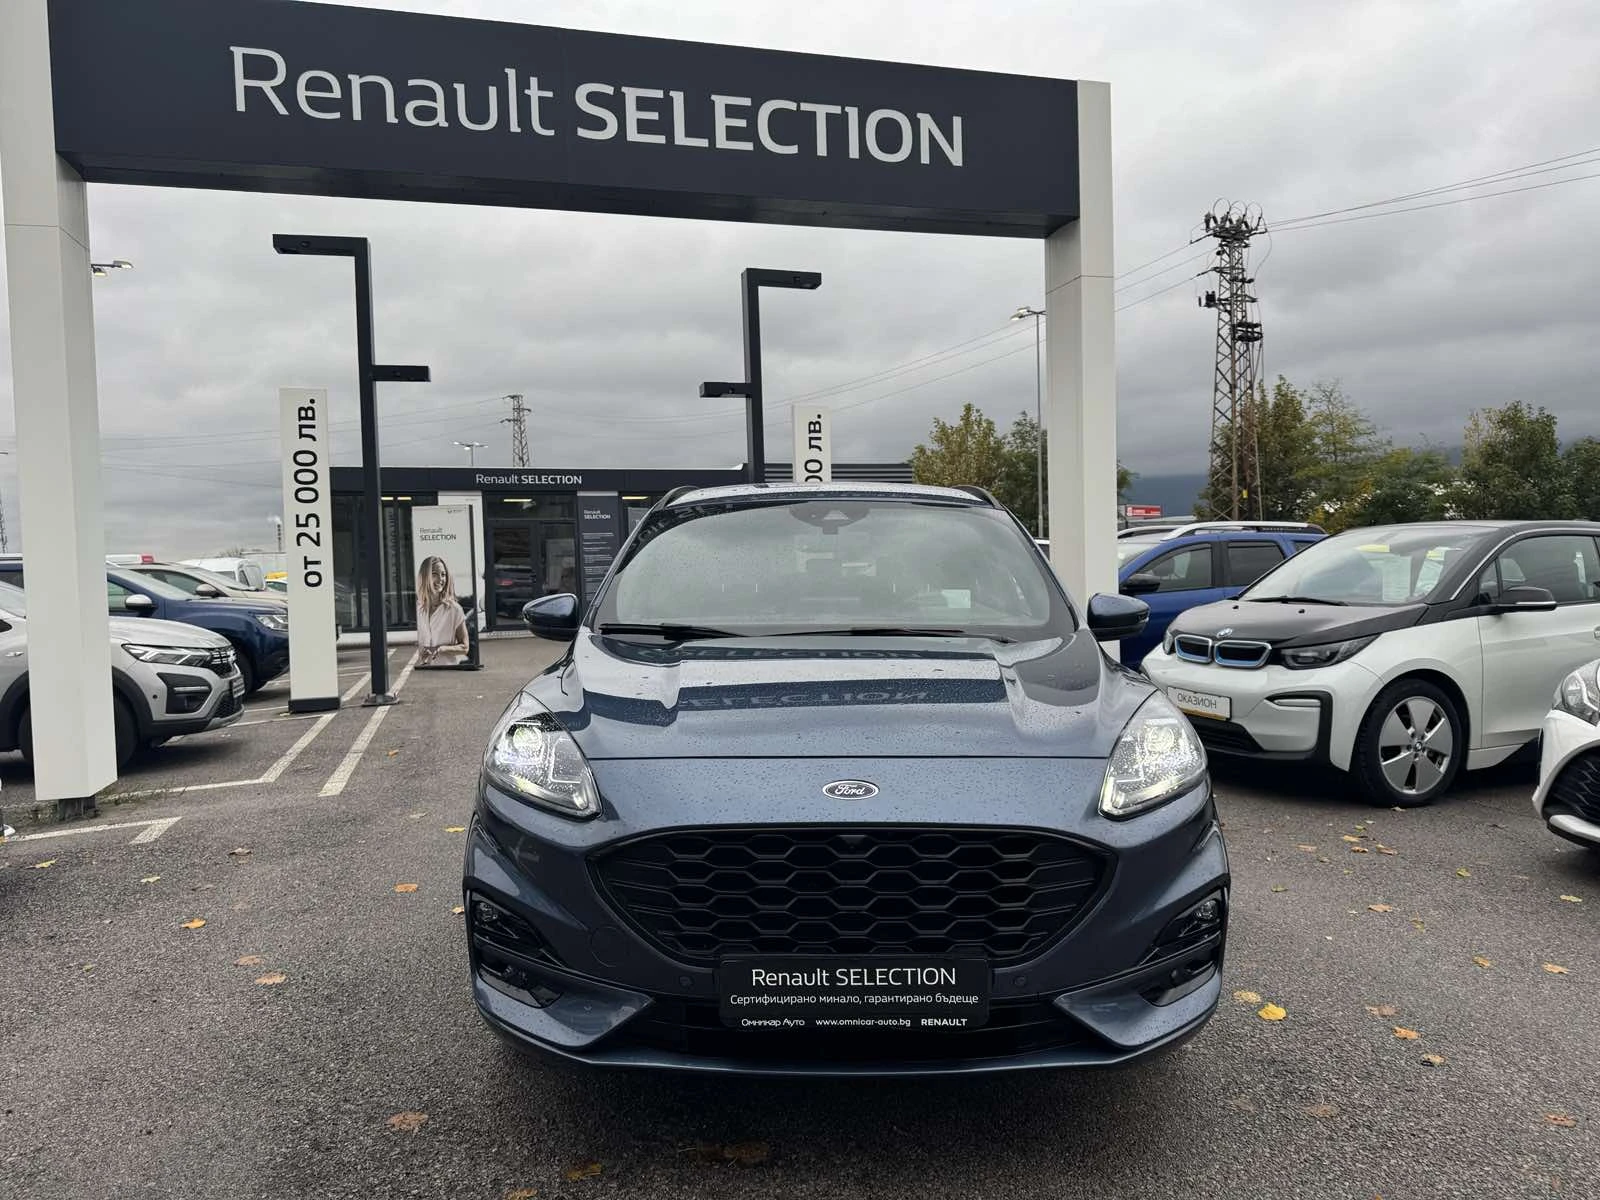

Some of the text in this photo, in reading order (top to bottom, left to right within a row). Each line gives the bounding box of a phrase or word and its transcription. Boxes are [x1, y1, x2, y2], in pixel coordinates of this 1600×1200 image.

[229, 46, 964, 167] Renault SELECTION
[293, 449, 319, 504] 000
[475, 473, 582, 485] Renault SELECTION
[295, 513, 321, 547] 25
[304, 556, 322, 588] от
[1177, 692, 1217, 709] ОКАЗИОН
[834, 784, 866, 796] Ford
[751, 967, 957, 987] Renault SELECTION
[730, 993, 979, 1006] Сертифицирано минало, гарантирано бъдеще
[741, 1017, 806, 1028] Омникар Ауто
[815, 1017, 911, 1027] www.omnicar-auto.bg
[921, 1018, 968, 1026] RENAULT
